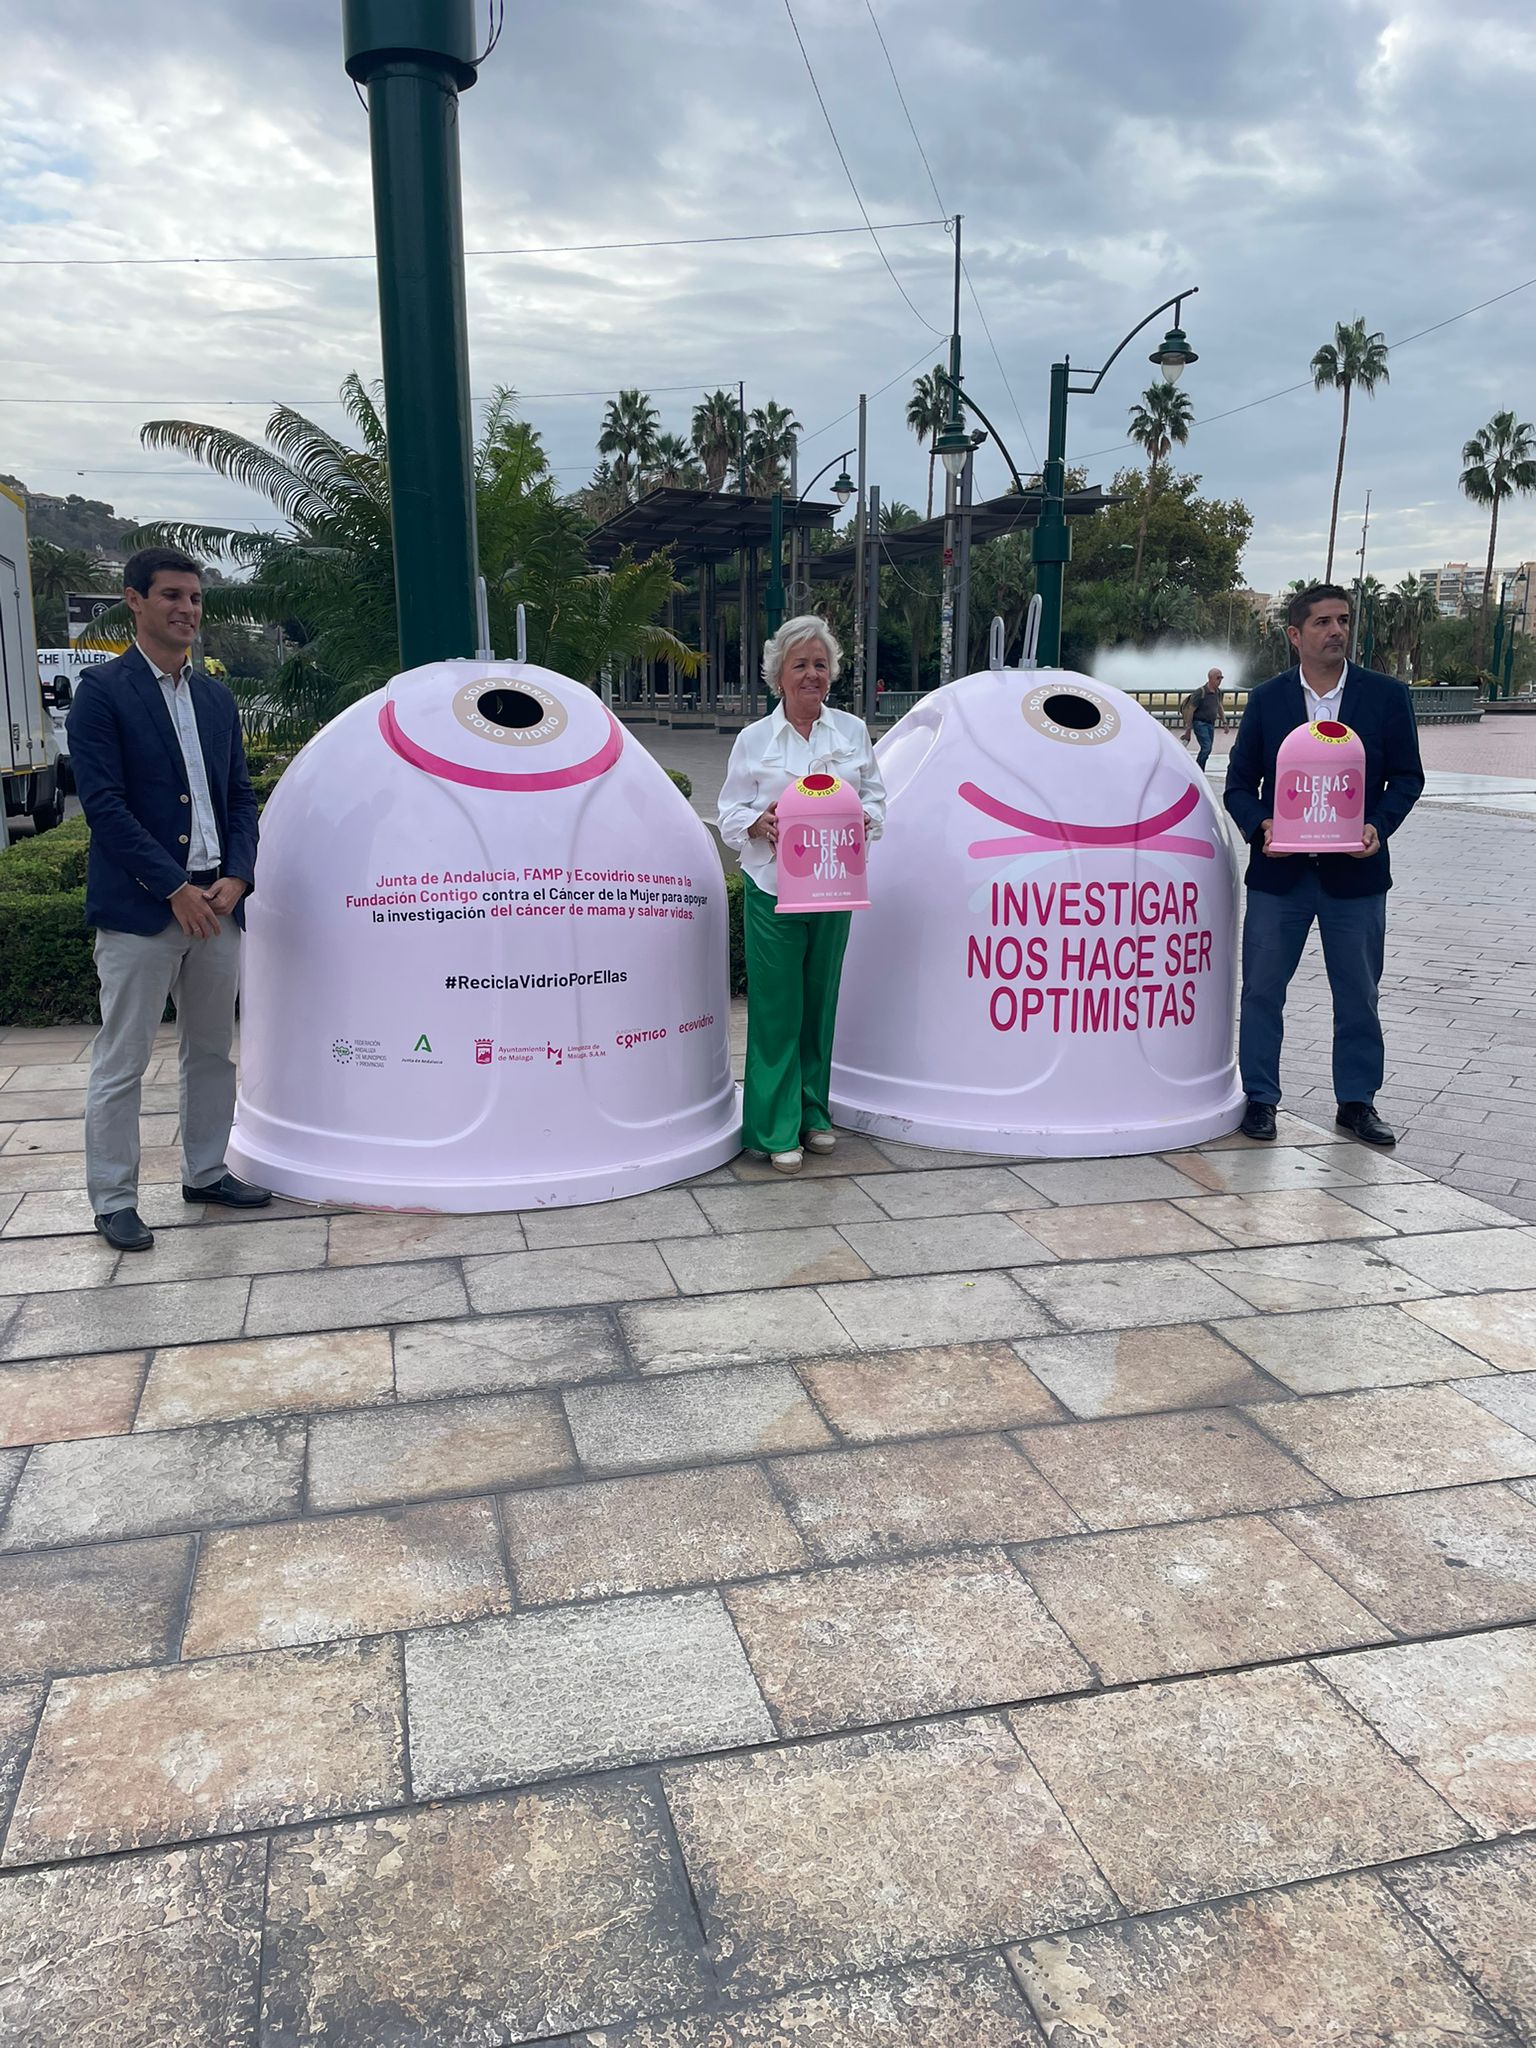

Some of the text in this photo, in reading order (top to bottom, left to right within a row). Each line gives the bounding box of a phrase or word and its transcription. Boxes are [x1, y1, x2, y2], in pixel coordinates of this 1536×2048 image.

[67, 654, 106, 664] TALLER
[464, 680, 554, 705] SOLO VIDRIO
[1030, 690, 1049, 711] SOLO
[467, 713, 559, 740] SOLO VIDRIO
[1041, 713, 1114, 740] SOLO VIDRIO
[797, 784, 814, 796] SOLO
[1296, 775, 1349, 792] LLENAS
[1311, 790, 1330, 808] DE
[1303, 806, 1336, 823] VIDA
[803, 829, 855, 848] LLENAS
[821, 845, 839, 864] DE
[376, 875, 417, 887] Junta
[421, 873, 439, 885] de
[524, 868, 563, 881] FAMP
[566, 870, 573, 883] y
[575, 869, 635, 881] Ecovidrio
[637, 874, 650, 883] se
[652, 875, 676, 886] unen
[677, 878, 683, 886] a
[684, 876, 692, 887] la
[813, 861, 847, 880] VIDA
[345, 887, 708, 908] Fundación Contigo contra el Cáncer de la Mujer para apoyar
[991, 881, 1198, 926] INVESTIGAR
[372, 903, 695, 923] la investigación del cáncer de mama y salvar vidas.
[967, 930, 1212, 981] NOS HACE SER
[445, 970, 628, 989] #ReciclaVidrioPorEllas
[989, 981, 1196, 1033] OPTIMISTAS
[678, 1013, 714, 1033] ecovidrio
[616, 1028, 666, 1049] CONTIGO
[498, 1046, 546, 1054] Ayuntamiento
